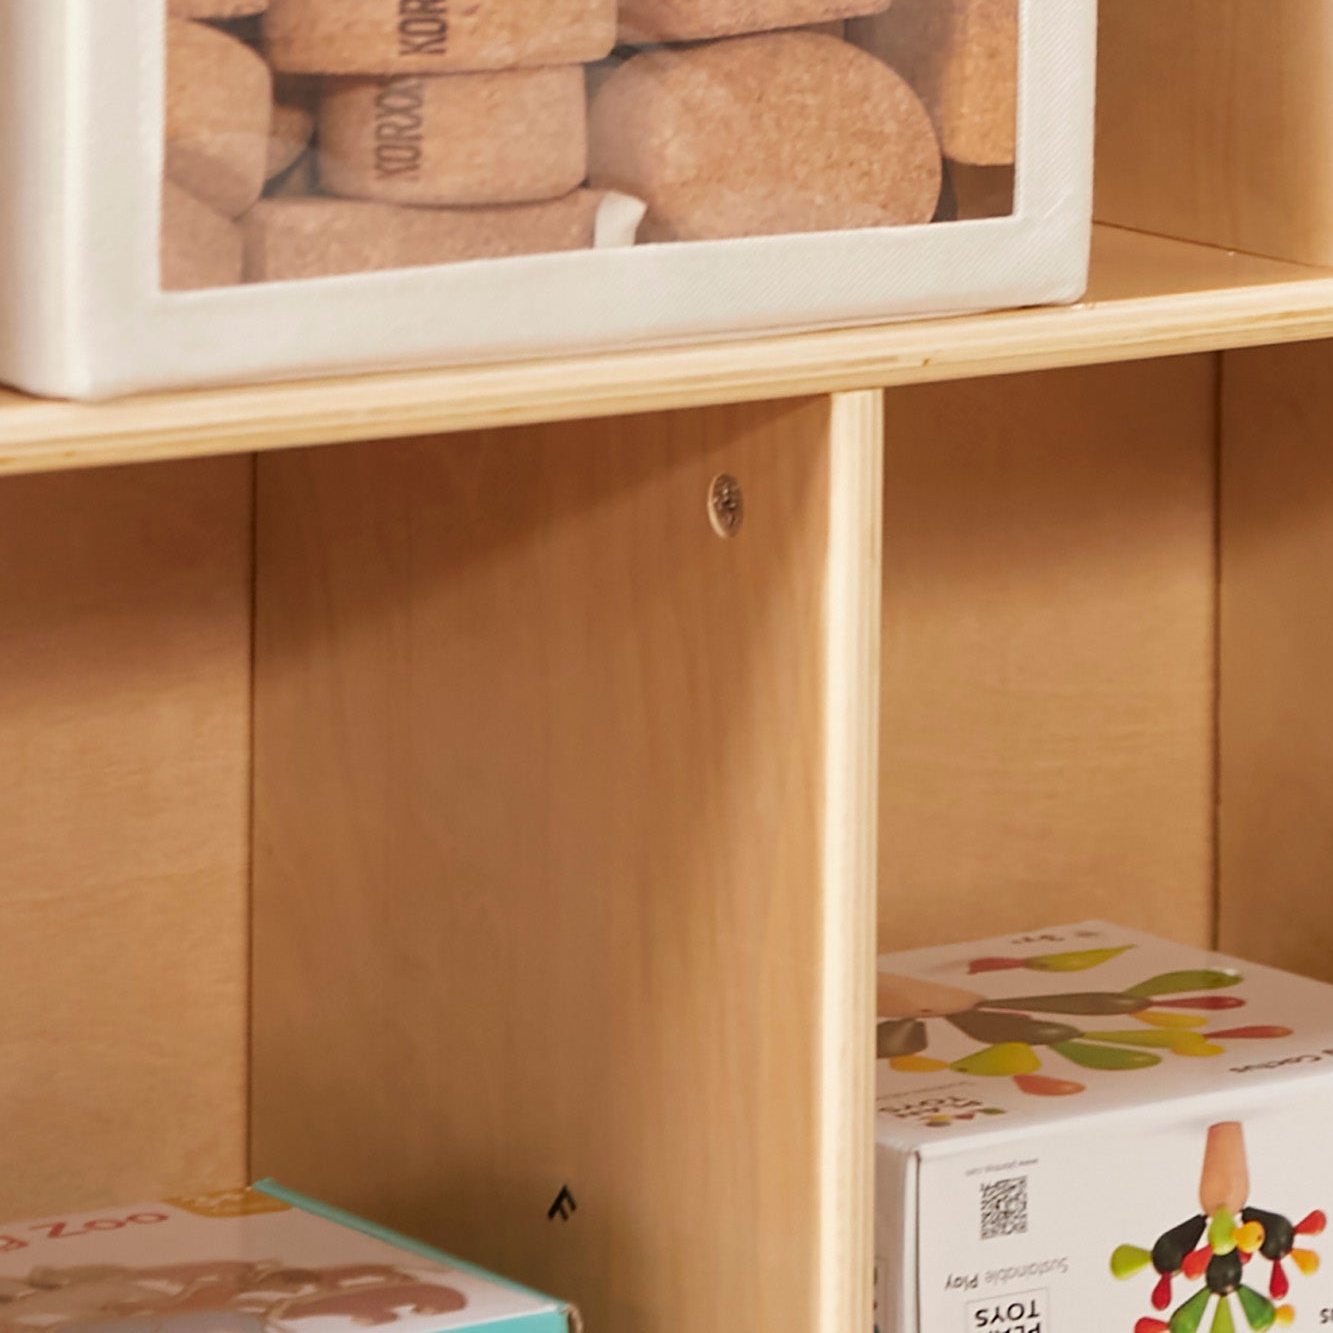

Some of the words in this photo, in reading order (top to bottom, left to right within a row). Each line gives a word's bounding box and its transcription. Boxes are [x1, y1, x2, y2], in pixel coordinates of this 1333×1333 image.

[373, 77, 425, 182] KORXX
[29, 1212, 169, 1239] Zoo
[944, 1273, 979, 1292] Play
[984, 1257, 1069, 1285] Sustainable
[974, 1299, 1040, 1327] TOYS
